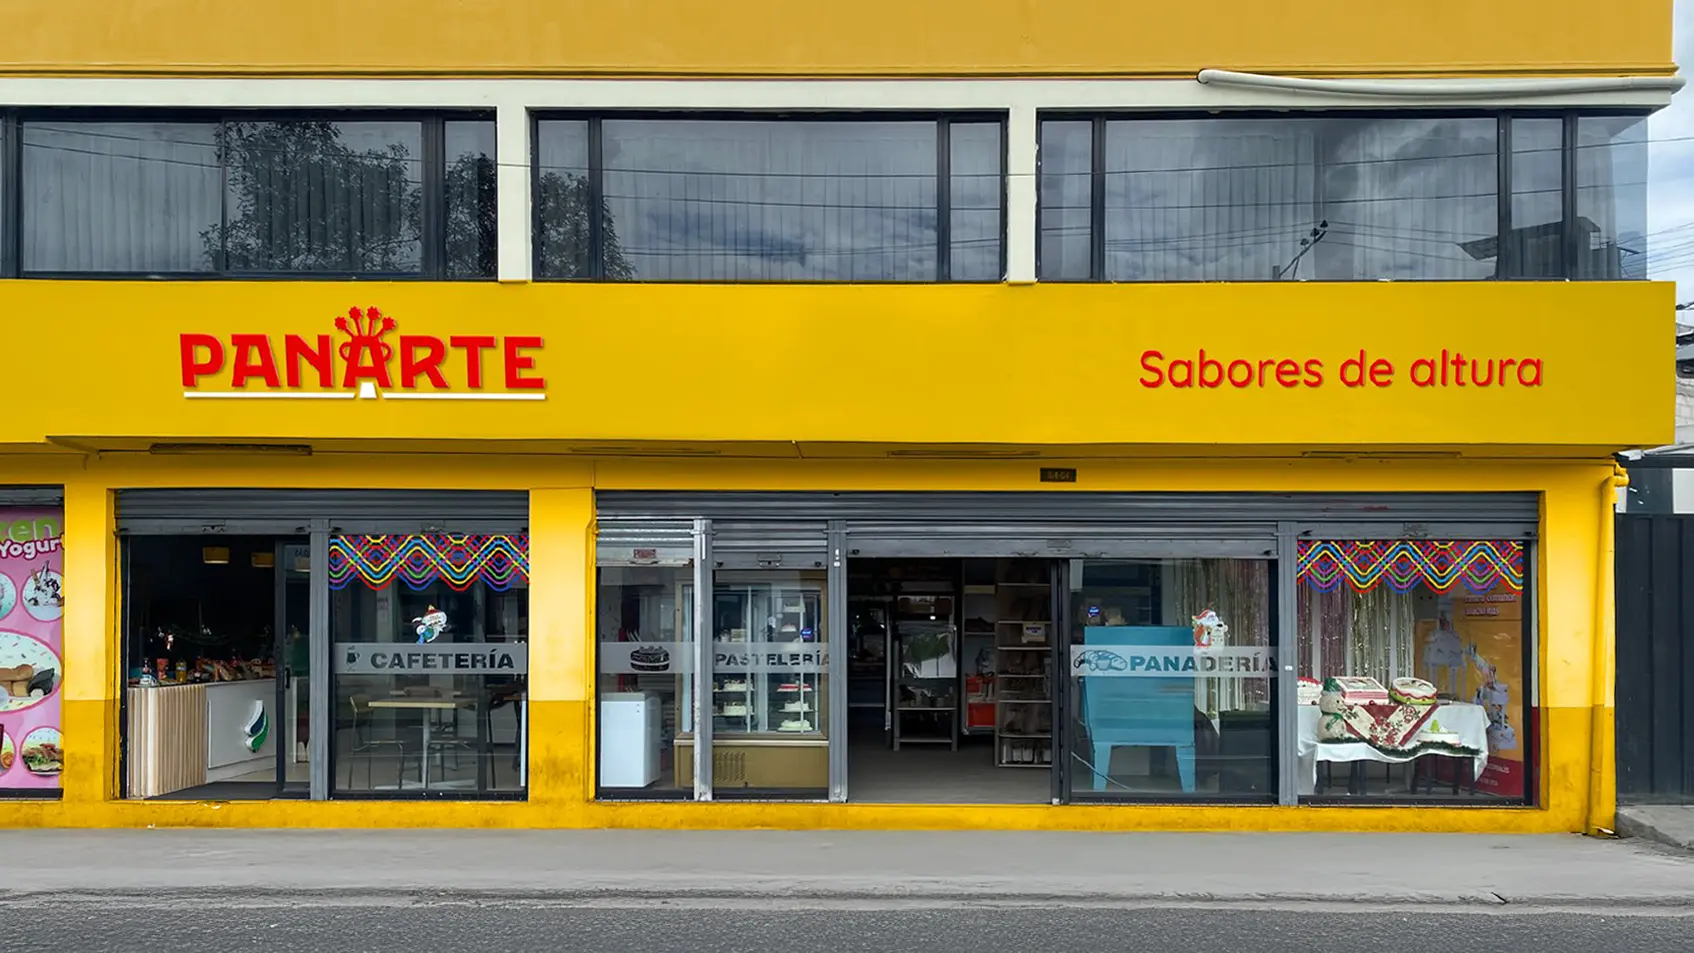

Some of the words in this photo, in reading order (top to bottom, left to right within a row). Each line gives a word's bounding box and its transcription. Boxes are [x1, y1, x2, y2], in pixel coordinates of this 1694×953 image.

[180, 333, 546, 388] PANARTE
[1139, 349, 1324, 388] Sabores
[1339, 349, 1394, 387] de
[1410, 349, 1543, 387] altura
[370, 648, 515, 669] CAFETERÍA
[715, 650, 830, 666] PASTELERÍA
[1130, 651, 1279, 672] PANADERÍA
